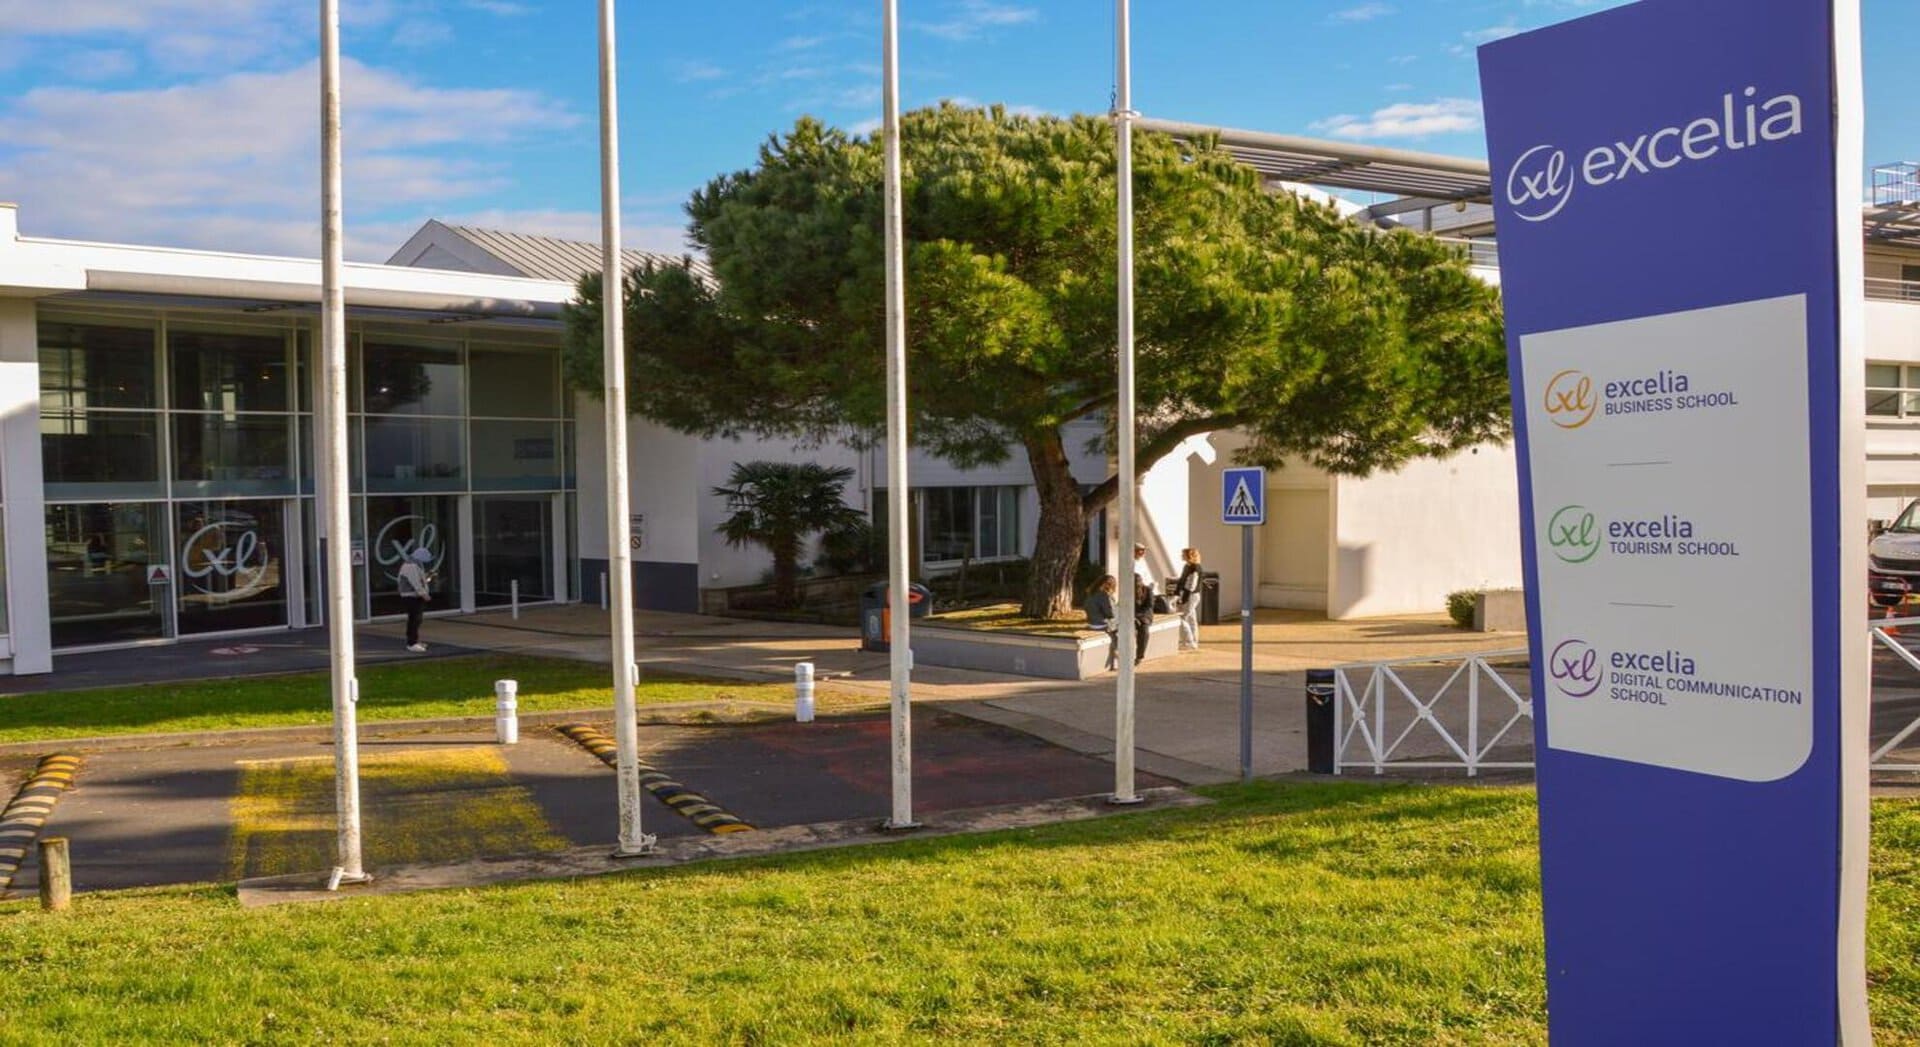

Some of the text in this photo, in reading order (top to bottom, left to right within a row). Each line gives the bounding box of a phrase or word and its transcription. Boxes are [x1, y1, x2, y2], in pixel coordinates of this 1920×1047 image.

[1583, 86, 1802, 186] excelia
[1605, 370, 1688, 398] excelia
[1605, 392, 1738, 415] BUSINESS SCHOOL
[1609, 515, 1692, 538] excelia
[1609, 541, 1740, 556] TOURISM SCHOOL
[1611, 651, 1694, 675] excelia
[1610, 672, 1802, 705] DIGITAL COMMUNICATION
[1610, 687, 1667, 706] SCHOOL
